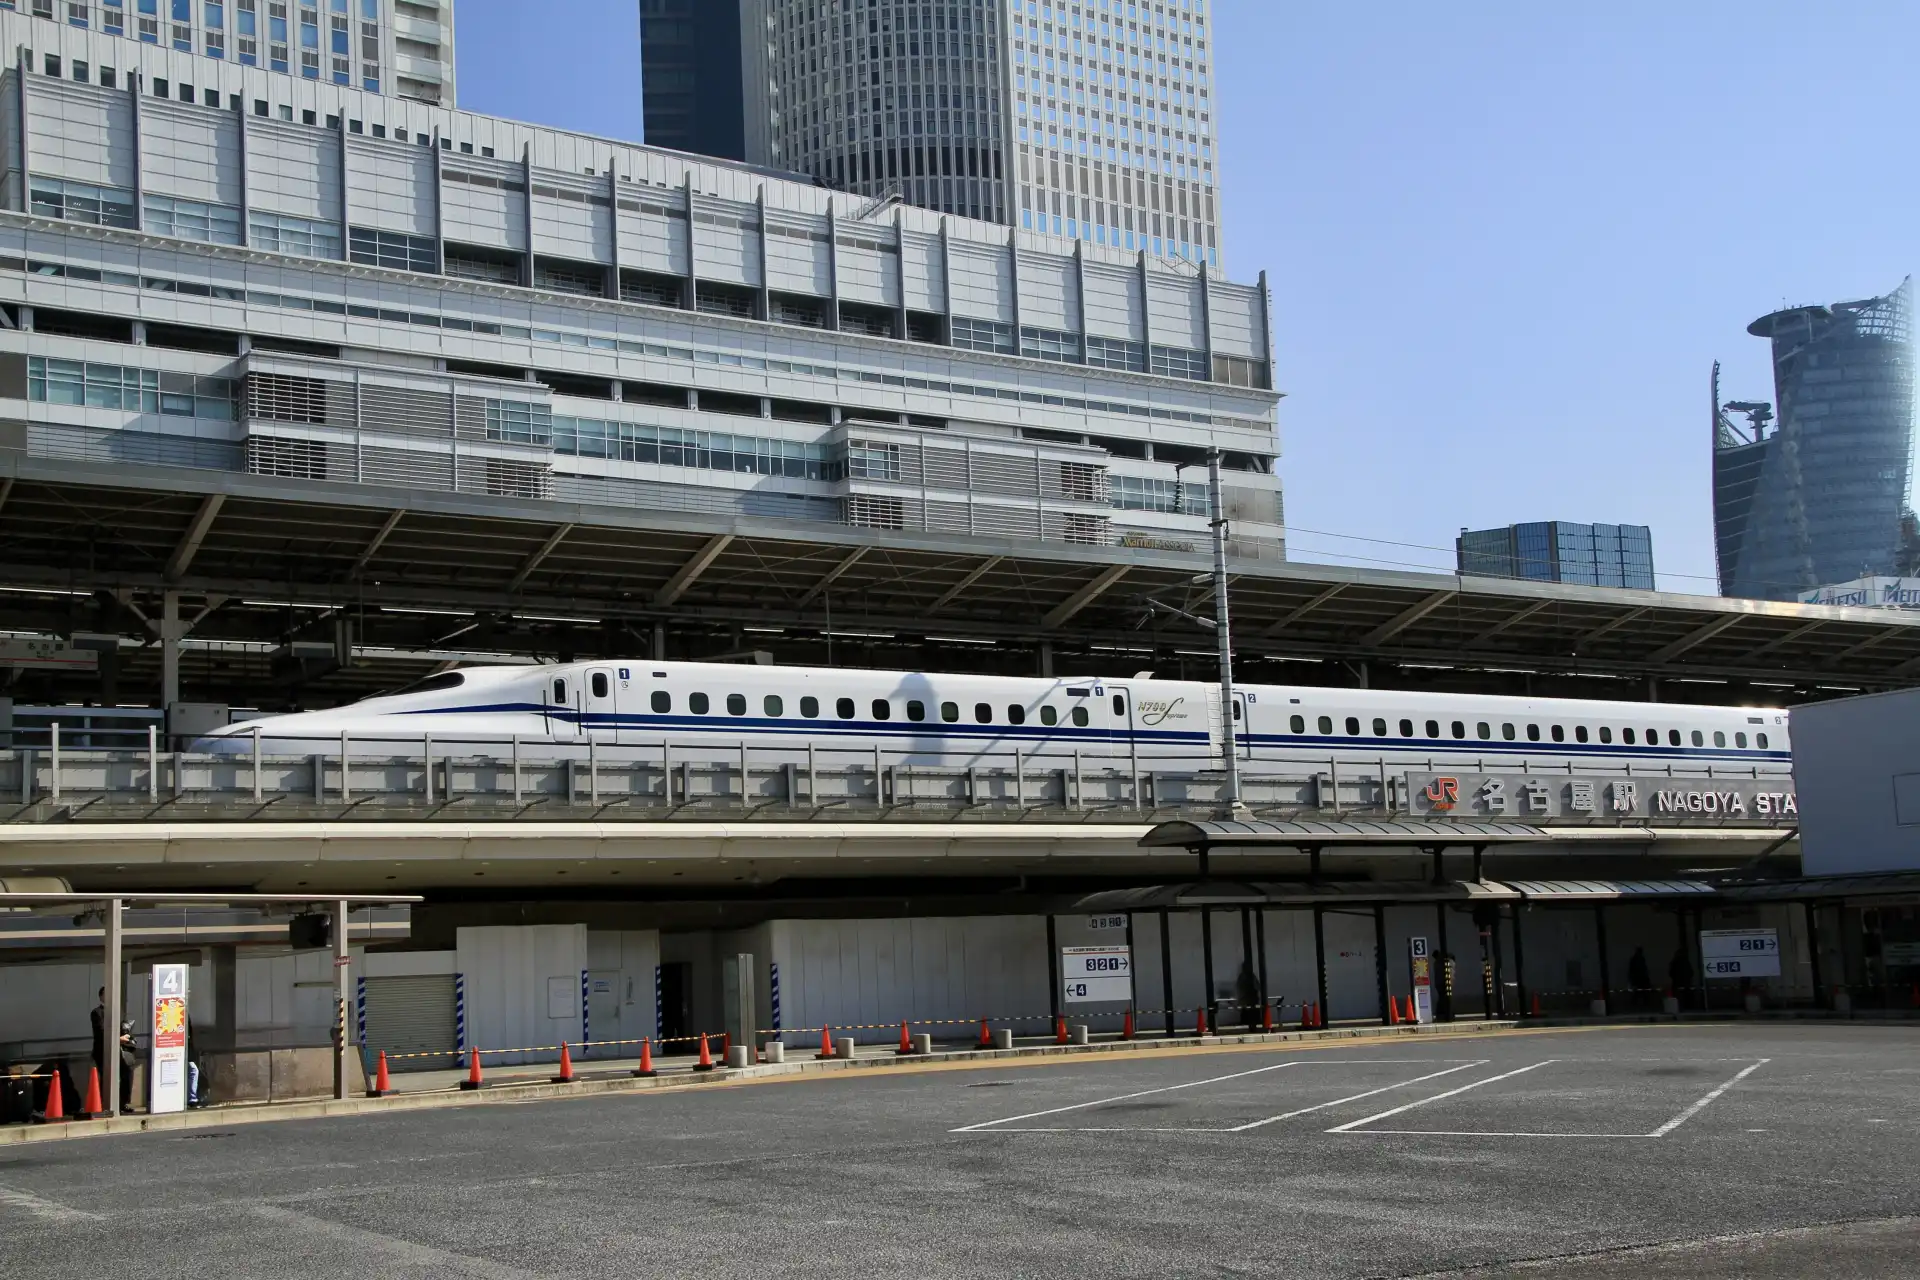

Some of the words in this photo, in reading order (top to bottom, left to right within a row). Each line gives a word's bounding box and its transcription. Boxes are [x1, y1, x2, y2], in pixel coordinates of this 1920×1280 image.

[1883, 577, 1920, 602] MEIT
[1137, 701, 1167, 712] N700
[1427, 776, 1460, 801] JR
[1482, 777, 1638, 811] 名古屋駅
[1657, 790, 1746, 813] NAGOYA
[1756, 792, 1798, 814] STA
[1415, 940, 1423, 954] 3
[1742, 940, 1750, 950] 2
[1087, 960, 1095, 970] 3
[1099, 959, 1106, 969] 2
[1719, 963, 1726, 972] 3
[1731, 962, 1738, 971] 4
[163, 970, 178, 992] 4
[1078, 985, 1085, 995] 4
